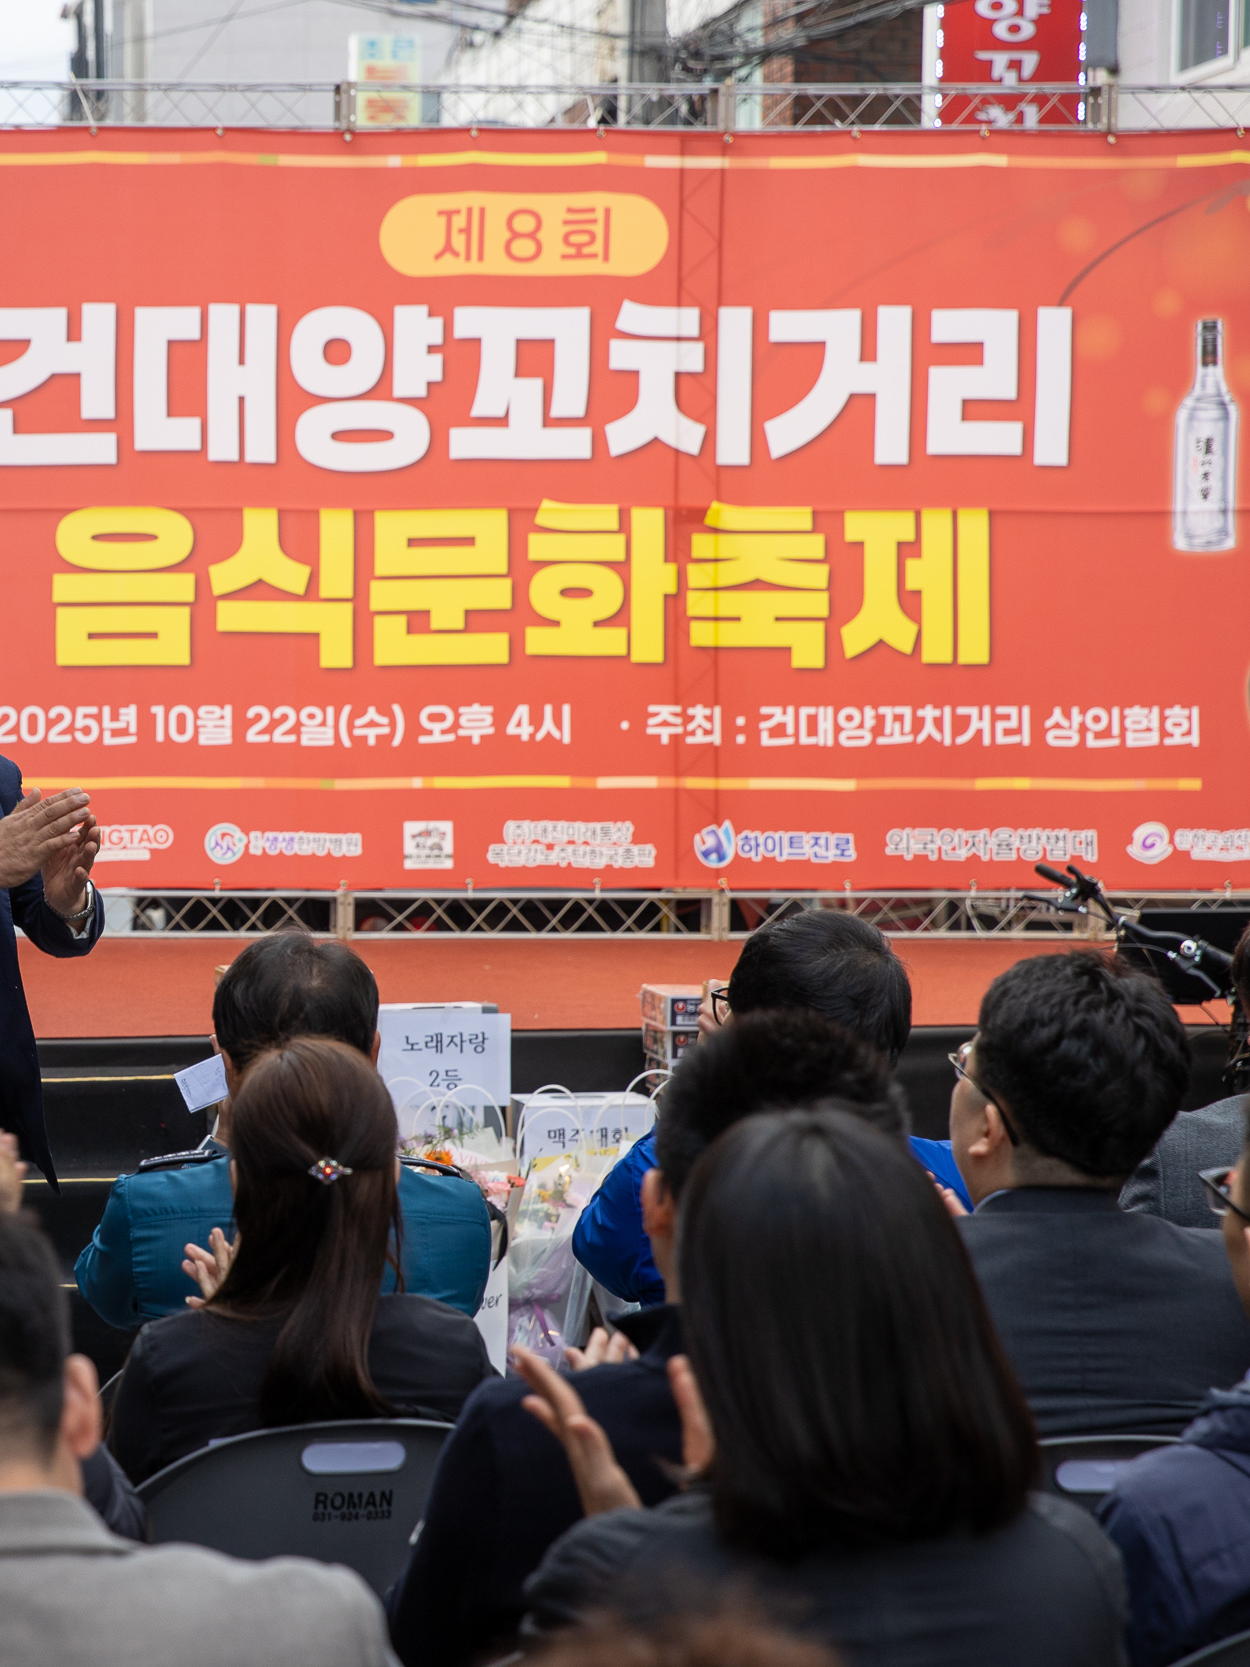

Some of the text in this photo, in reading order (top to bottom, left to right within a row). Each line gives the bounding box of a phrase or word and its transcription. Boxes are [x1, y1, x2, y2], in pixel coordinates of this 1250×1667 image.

[52, 498, 991, 669] 음식문화축제
[150, 704, 233, 746] 10월
[245, 703, 406, 748] 22일(수)
[418, 702, 496, 745] 오후
[506, 703, 571, 745] 4시
[758, 704, 1031, 748] 건대양꼬치거리
[1044, 704, 1200, 748] 상인협회
[740, 834, 853, 860] 하이트진로
[888, 830, 1095, 860] 외국인자율방범대
[402, 1031, 489, 1055] 노래자랑
[428, 1069, 462, 1091] 2등
[314, 1489, 393, 1511] ROMAN
